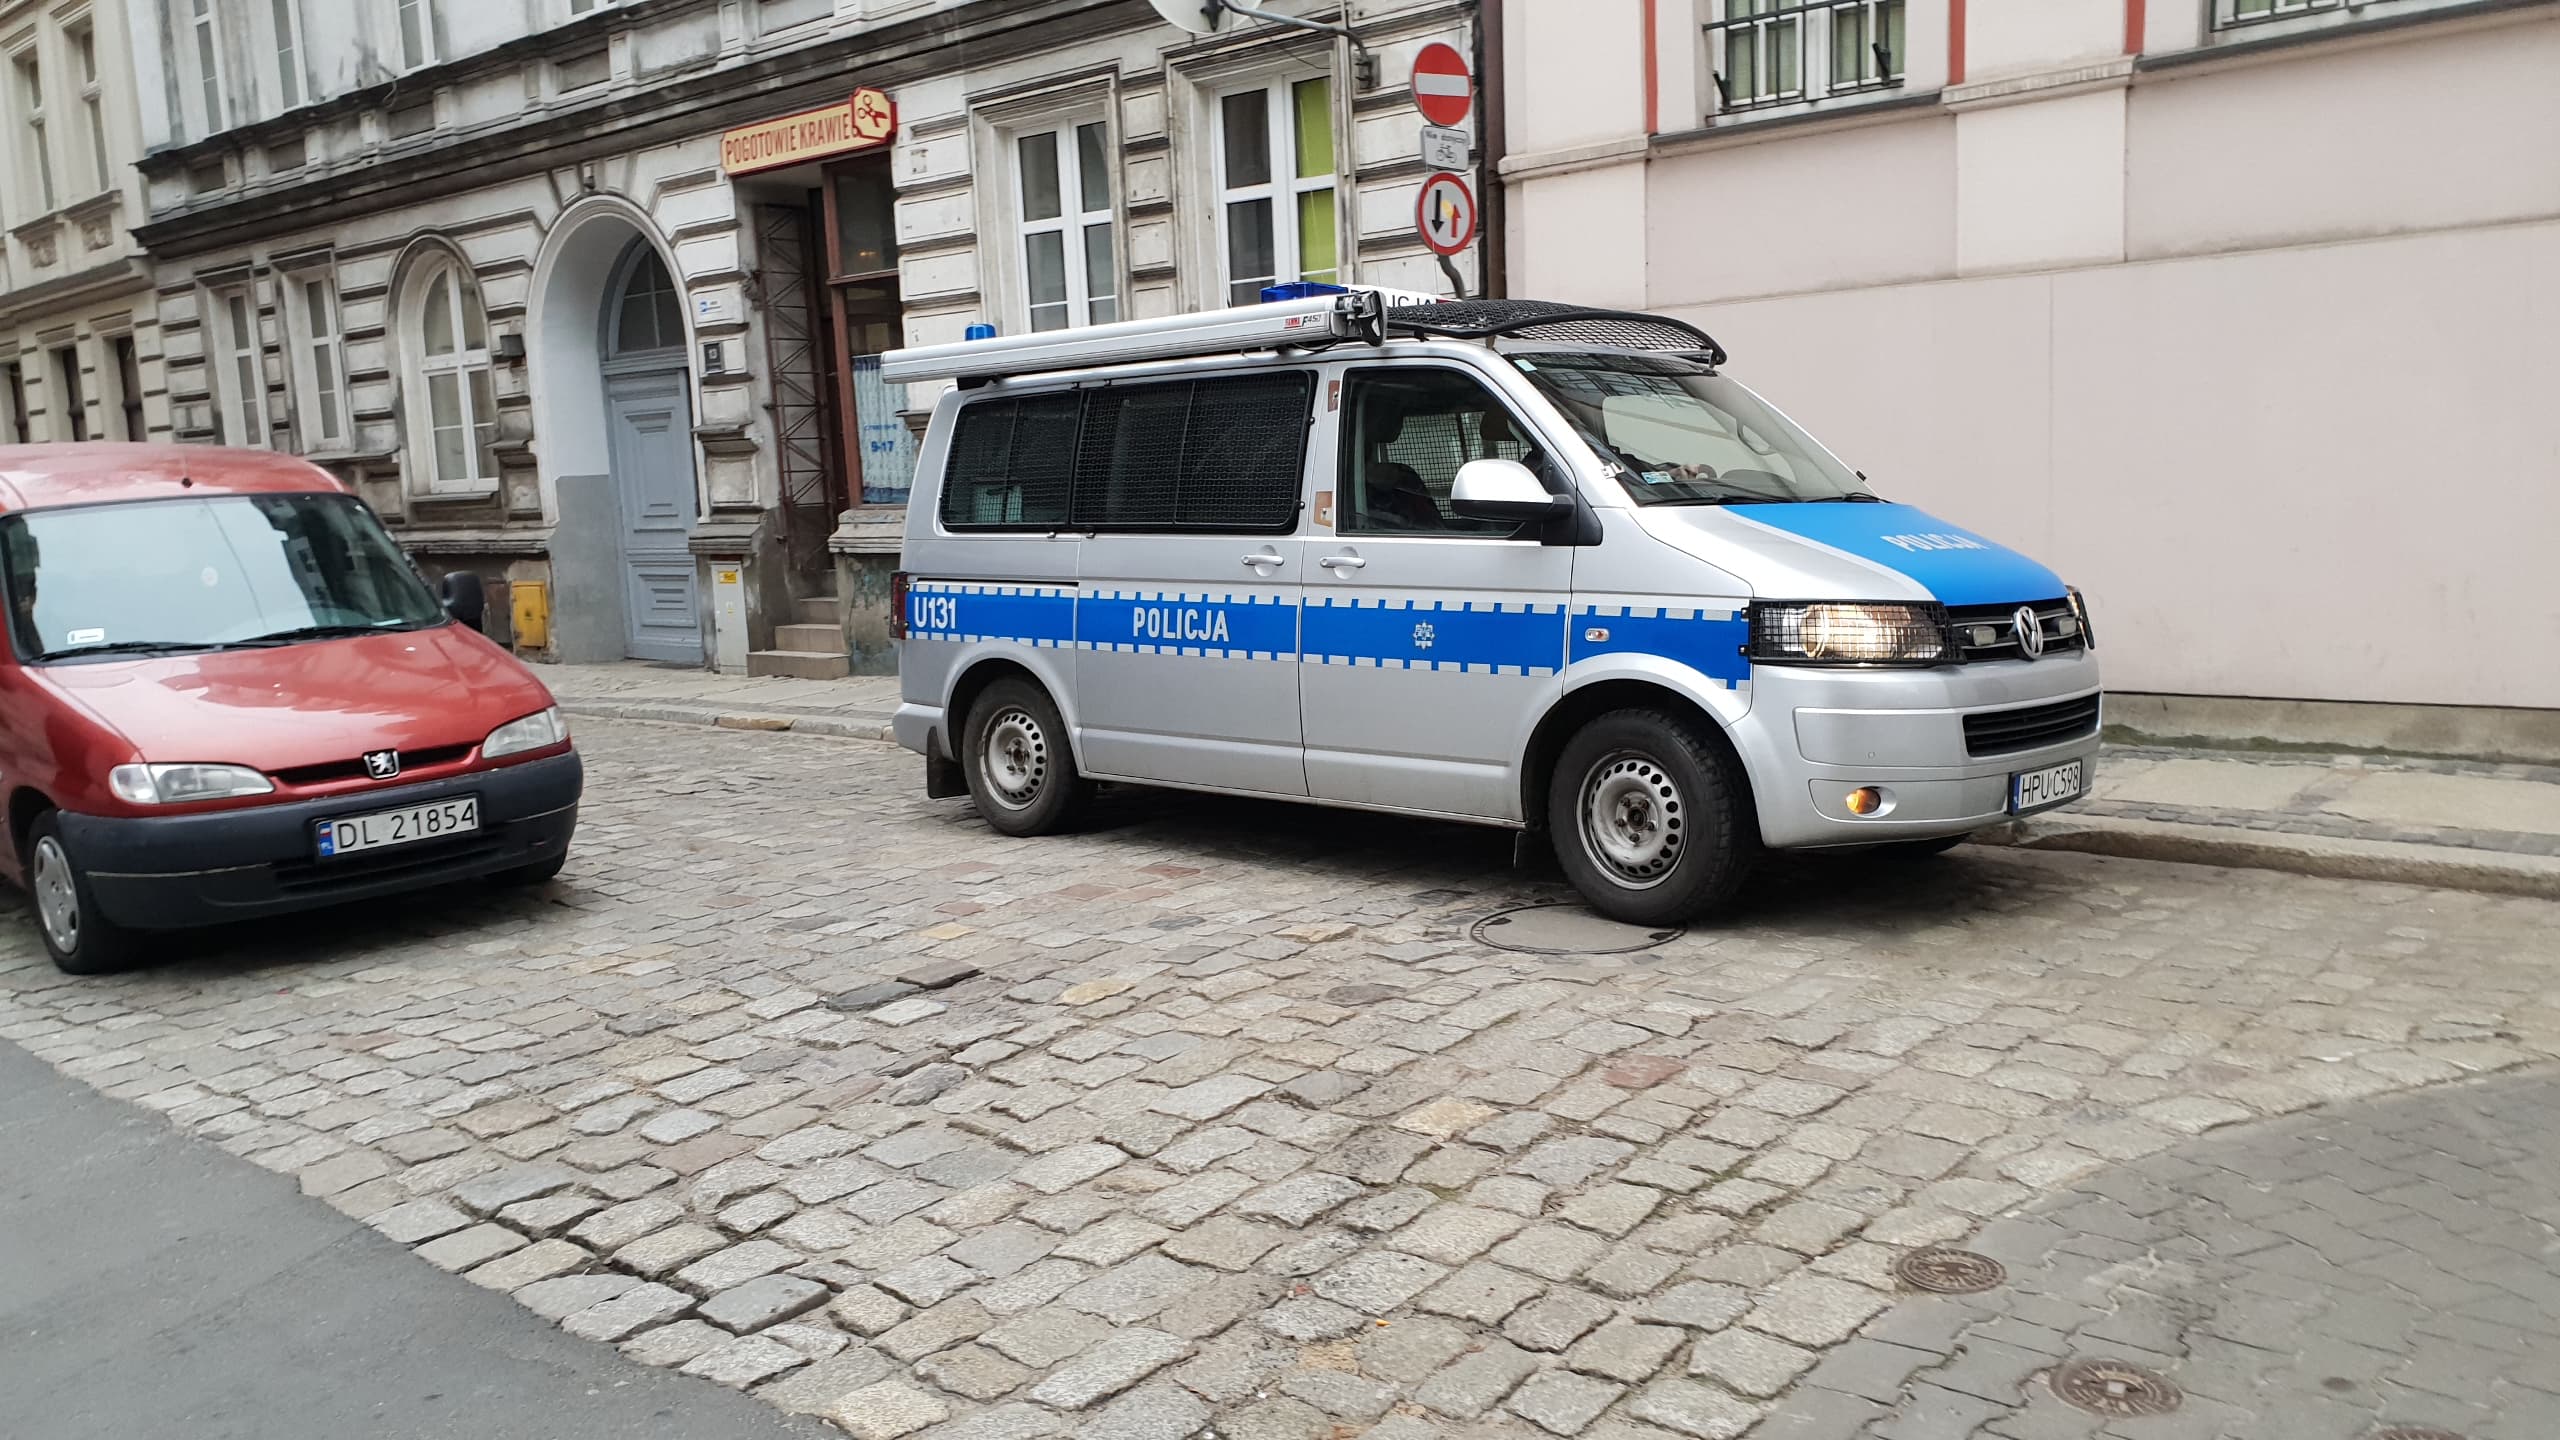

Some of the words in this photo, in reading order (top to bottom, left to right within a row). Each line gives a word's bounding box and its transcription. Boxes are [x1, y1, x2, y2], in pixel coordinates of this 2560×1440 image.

[725, 125, 797, 165] POGOTOWIE
[1880, 533, 1991, 552] POLICJA
[914, 597, 957, 629] U131
[1133, 607, 1230, 642] POLICJA
[2021, 774, 2050, 805] HPU
[2053, 765, 2079, 796] C598
[337, 820, 379, 849] DL
[391, 801, 475, 840] 21854
